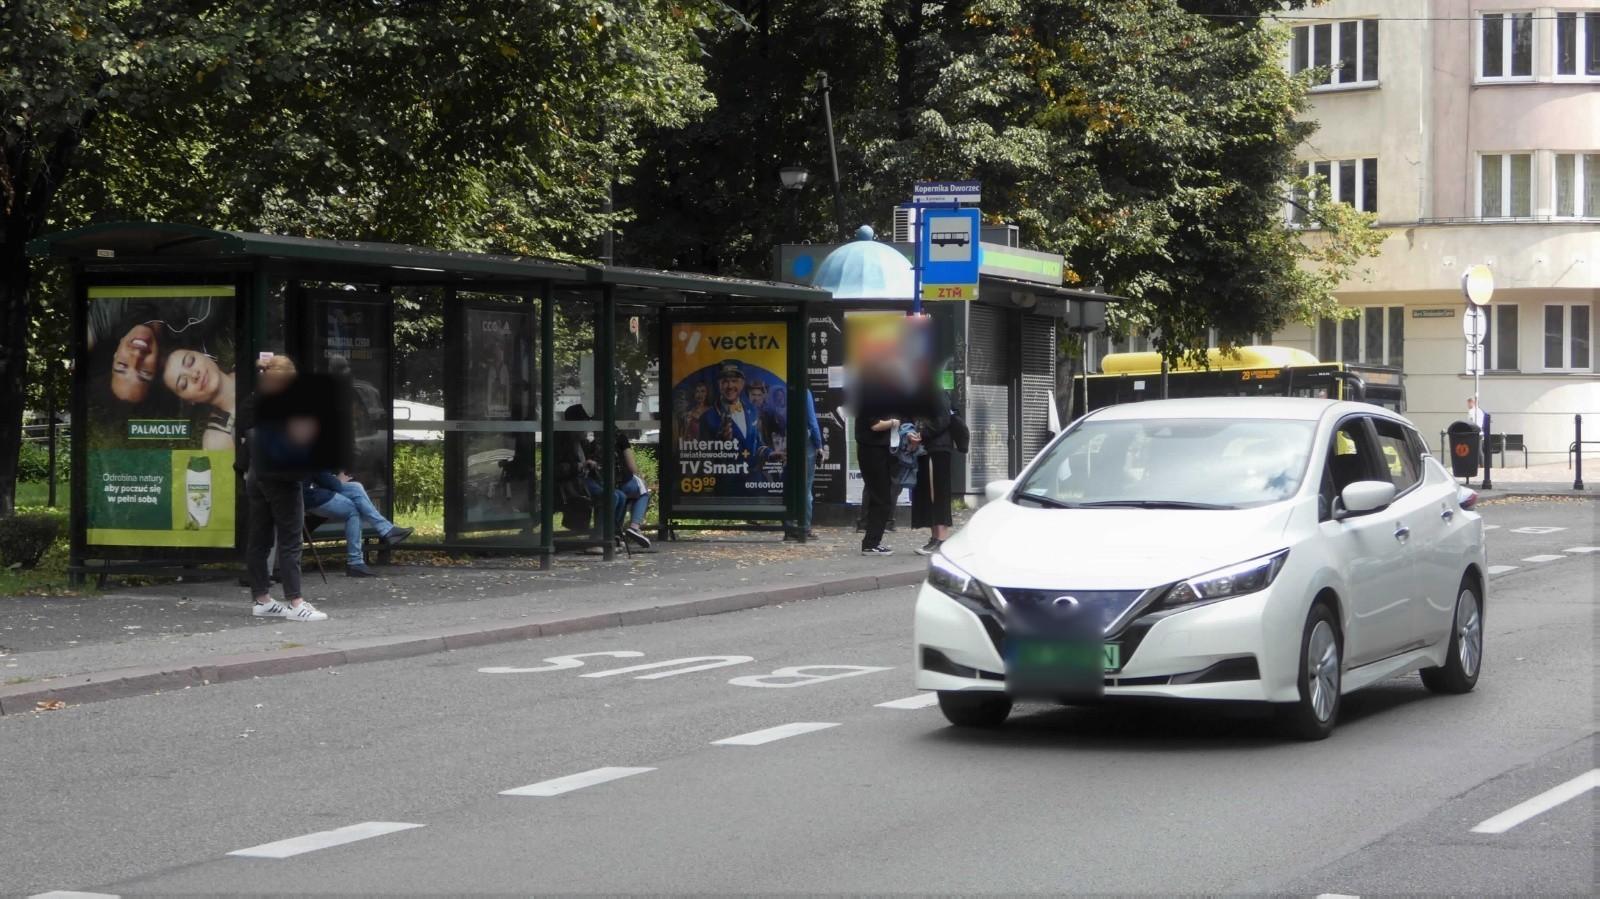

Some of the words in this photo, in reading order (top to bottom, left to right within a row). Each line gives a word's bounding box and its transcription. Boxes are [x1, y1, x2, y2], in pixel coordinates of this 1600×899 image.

[914, 184, 949, 194] Kopernika
[950, 184, 980, 192] Dworzec
[937, 287, 962, 298] ZTM
[708, 332, 780, 350] vectra
[131, 425, 187, 434] PALMOLIVE
[679, 437, 740, 451] Internet
[680, 450, 739, 460] światłowodowy
[679, 460, 701, 474] TV
[703, 461, 749, 475] Smart
[102, 473, 138, 482] Odrobina
[139, 474, 164, 484] natury
[104, 484, 119, 493] aby
[120, 484, 148, 493] poczuć
[149, 485, 162, 494] się
[117, 495, 137, 504] pełni
[138, 495, 158, 504] sobą
[477, 650, 897, 688] BUS
